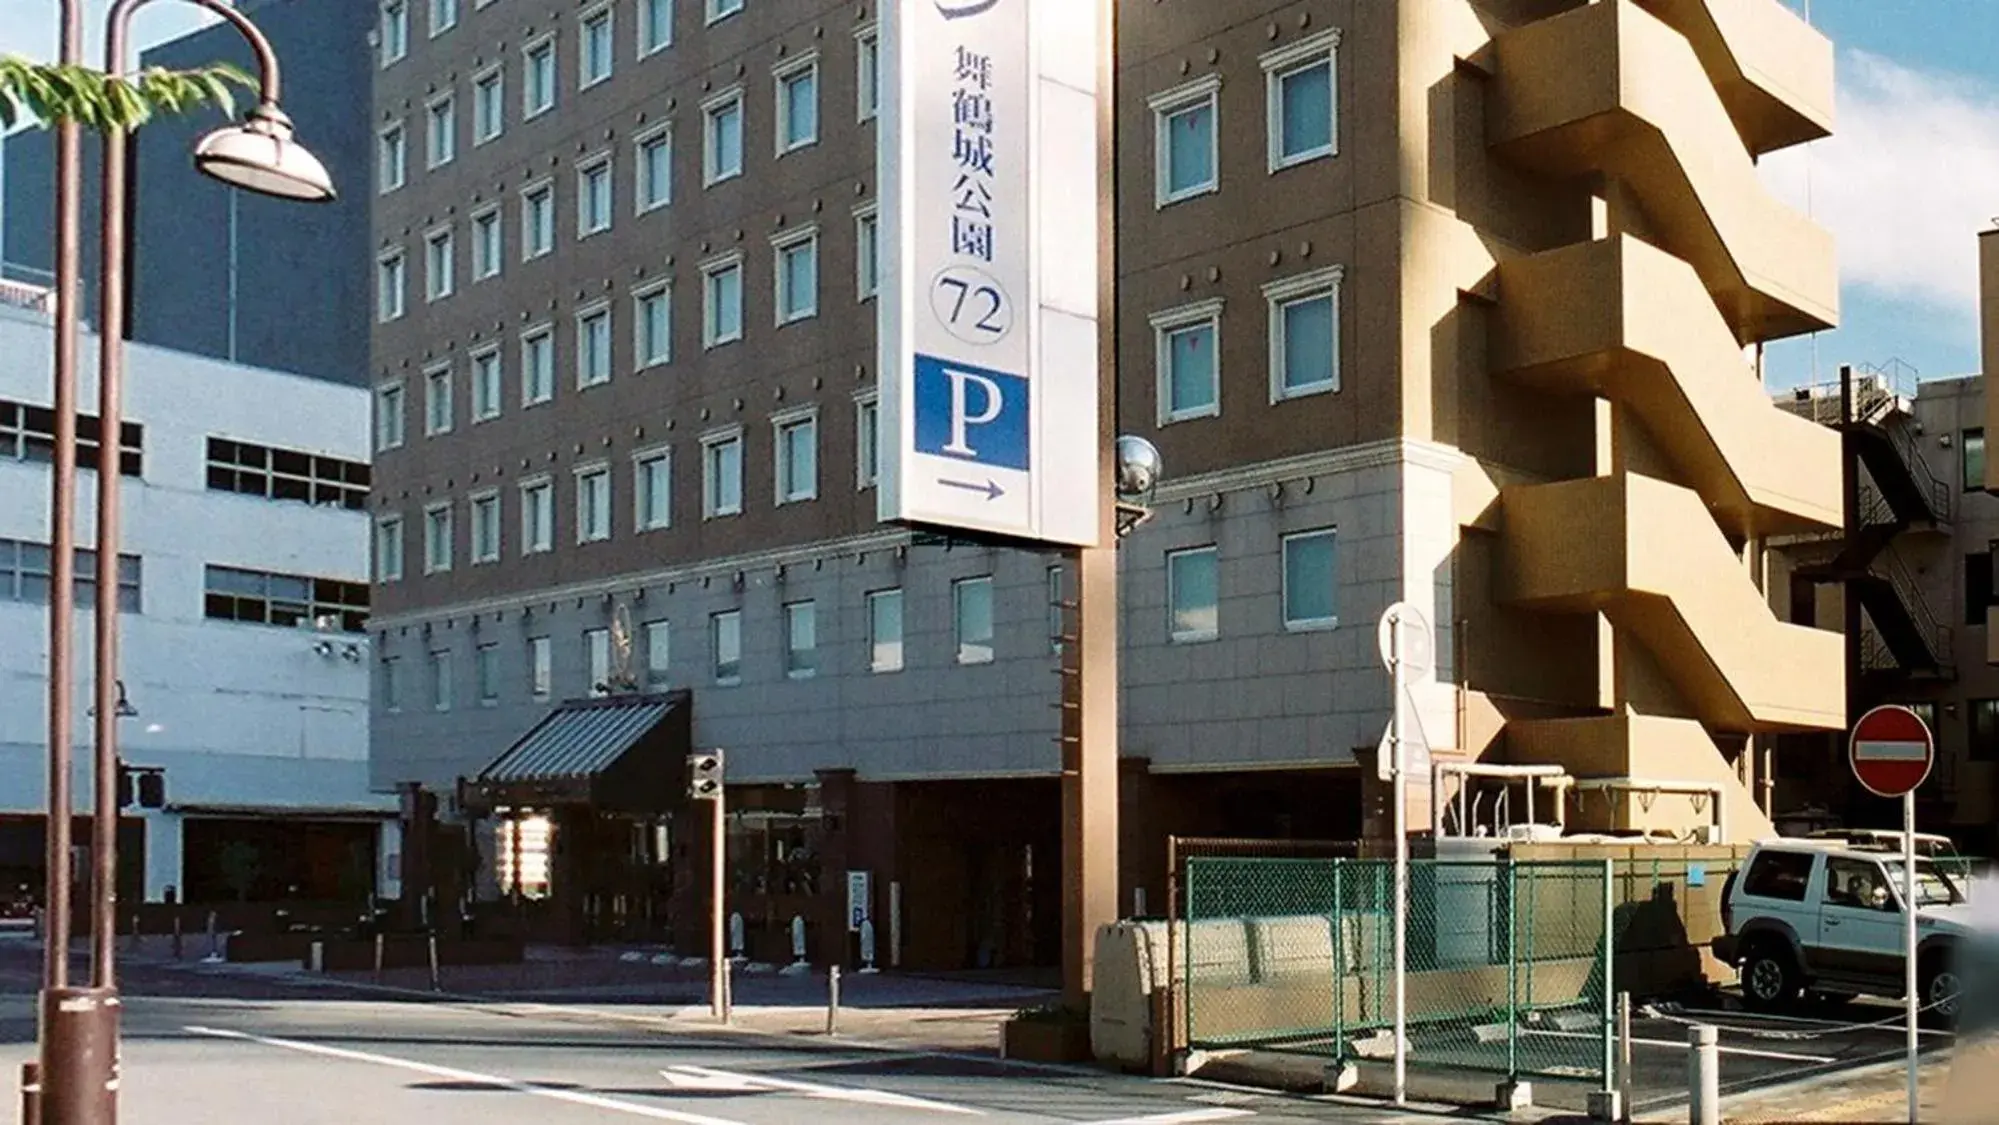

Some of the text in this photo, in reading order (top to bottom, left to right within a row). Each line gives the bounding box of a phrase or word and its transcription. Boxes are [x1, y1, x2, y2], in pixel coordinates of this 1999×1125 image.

[952, 45, 993, 262] 舞鶴城公園
[939, 277, 1003, 334] 72
[942, 368, 1004, 457] P
